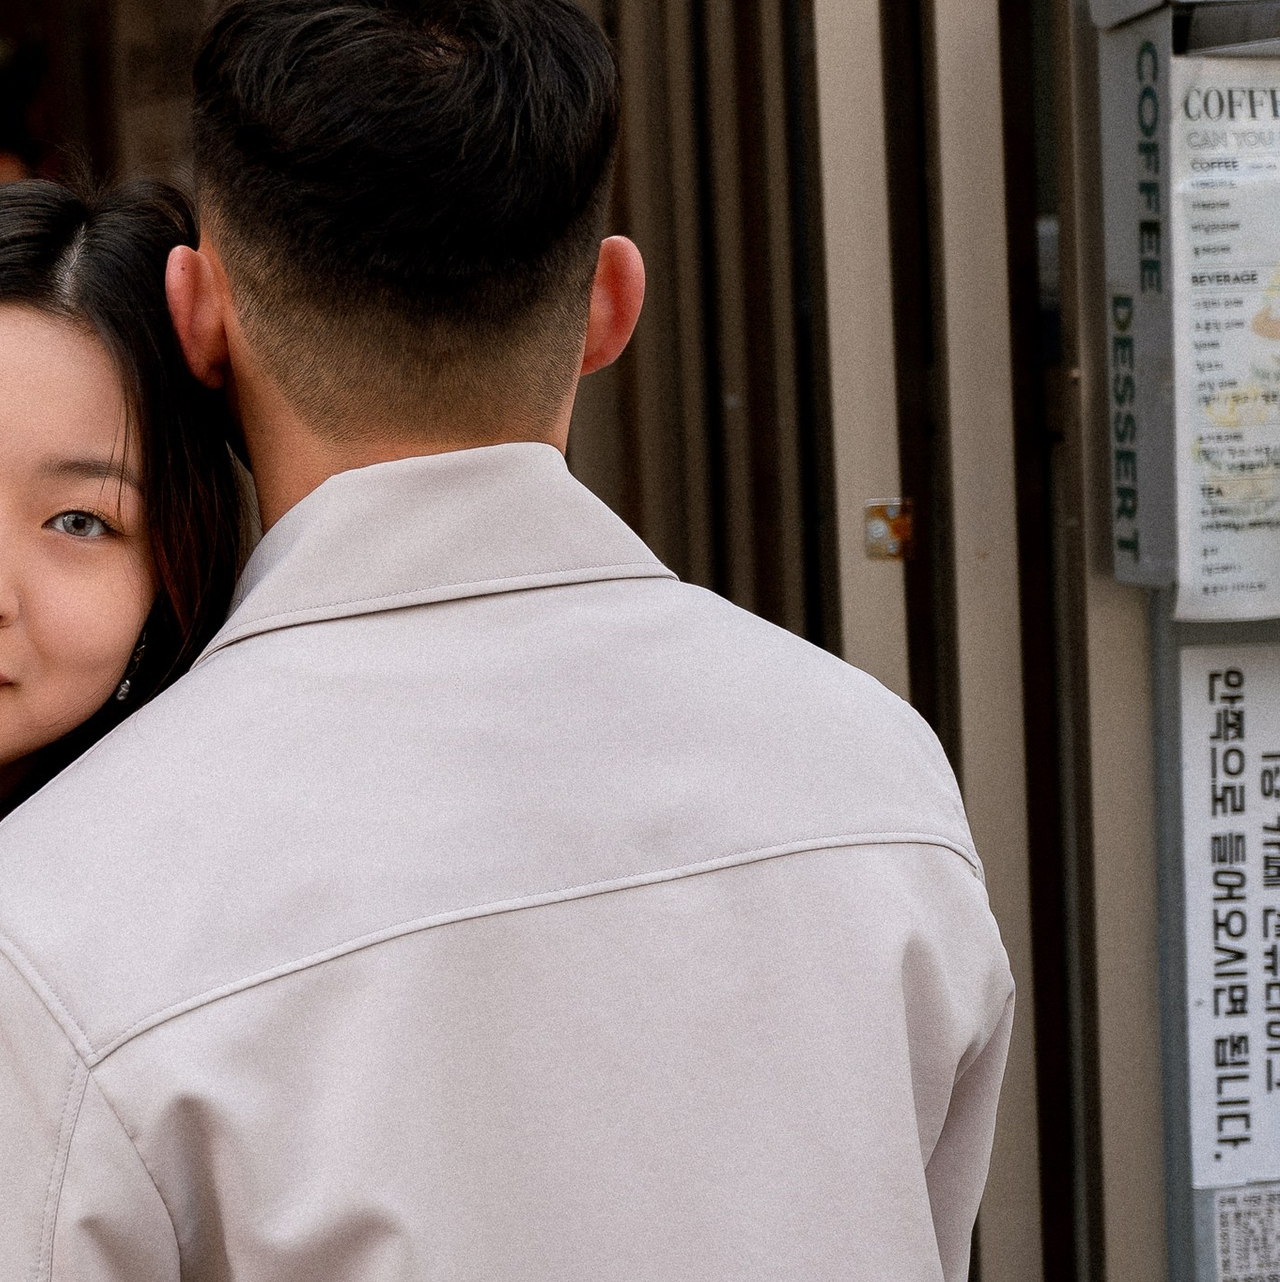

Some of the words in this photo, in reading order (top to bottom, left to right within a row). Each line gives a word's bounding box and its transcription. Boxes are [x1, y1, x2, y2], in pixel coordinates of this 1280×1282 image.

[1137, 40, 1162, 293] COFFEE
[1186, 131, 1228, 150] CAN
[1231, 130, 1275, 149] YOU
[1190, 160, 1239, 172] COFFEE
[1191, 273, 1258, 286] BEVERAGE
[1112, 297, 1139, 563] DESSERT
[1200, 485, 1223, 498] TEA
[1209, 670, 1245, 816] 안쪽으로
[1211, 833, 1248, 1016] 들어오시면
[1214, 1035, 1250, 1161] 됩니다.
